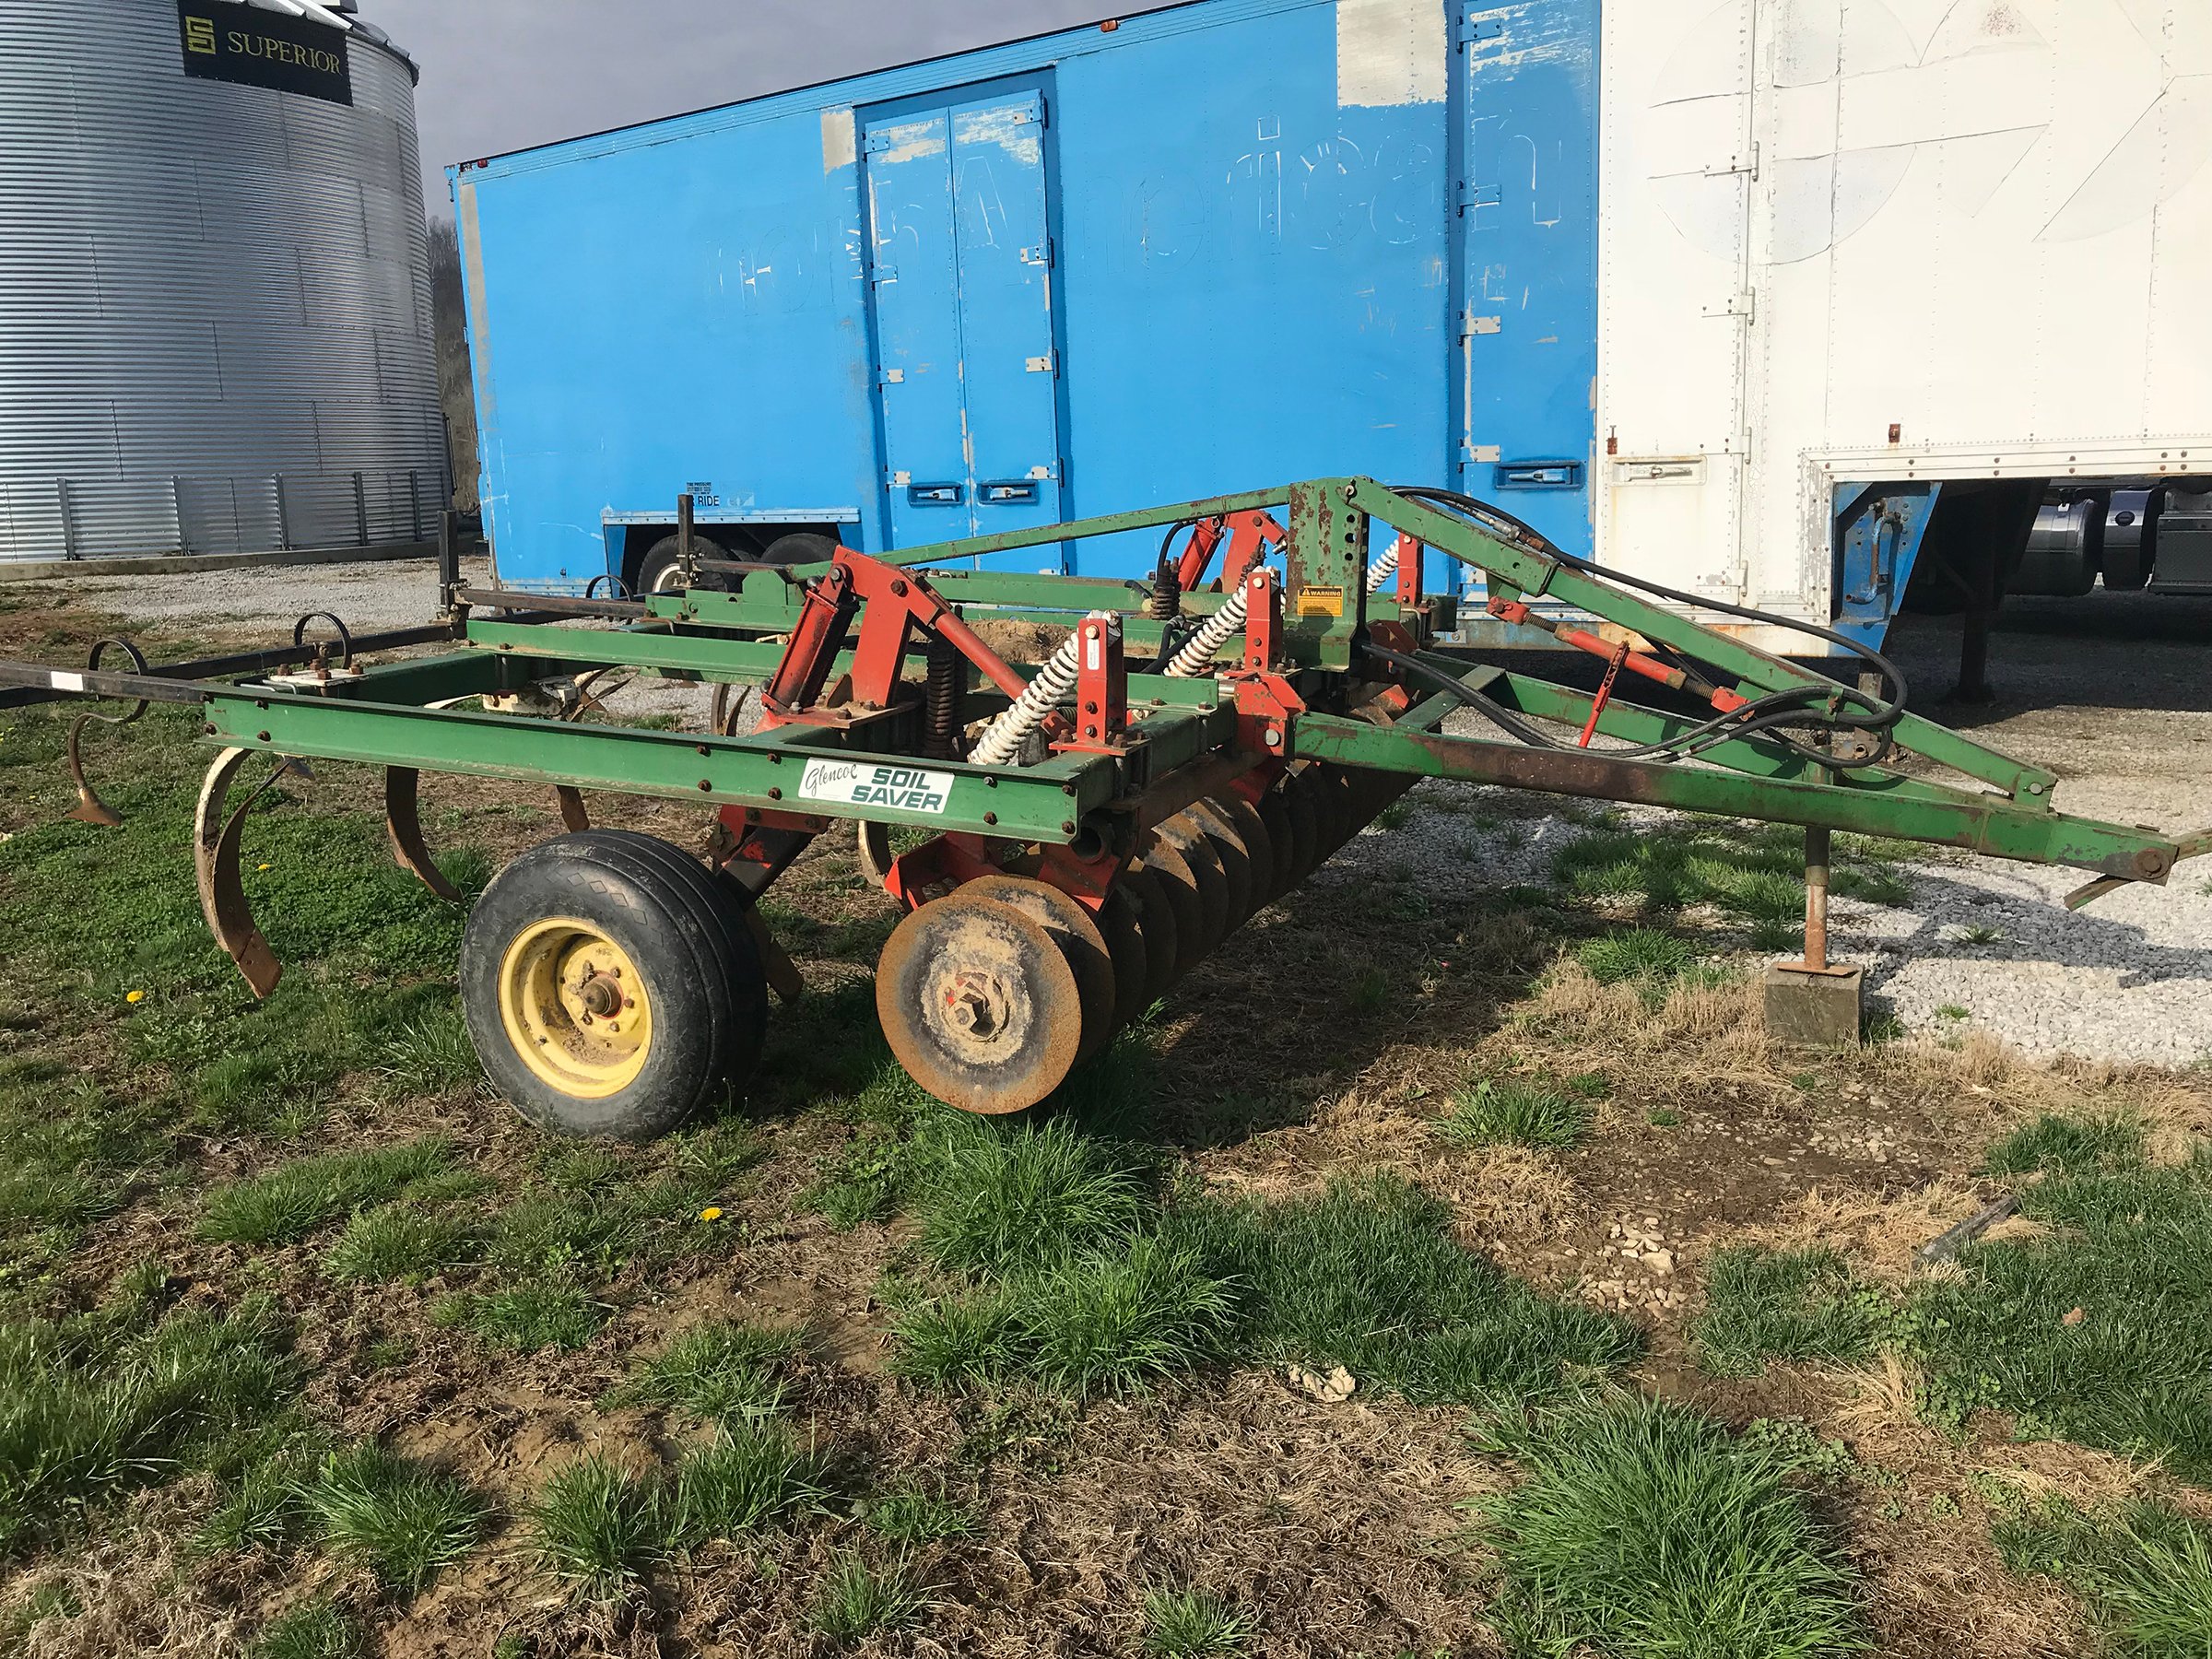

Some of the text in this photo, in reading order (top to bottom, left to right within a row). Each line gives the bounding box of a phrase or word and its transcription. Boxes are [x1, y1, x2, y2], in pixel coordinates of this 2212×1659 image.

[227, 30, 342, 75] SUPERIOR
[698, 496, 719, 506] RIDE
[805, 763, 858, 797] Glencoe
[871, 767, 931, 791] SOIL
[851, 784, 943, 811] SAVER
